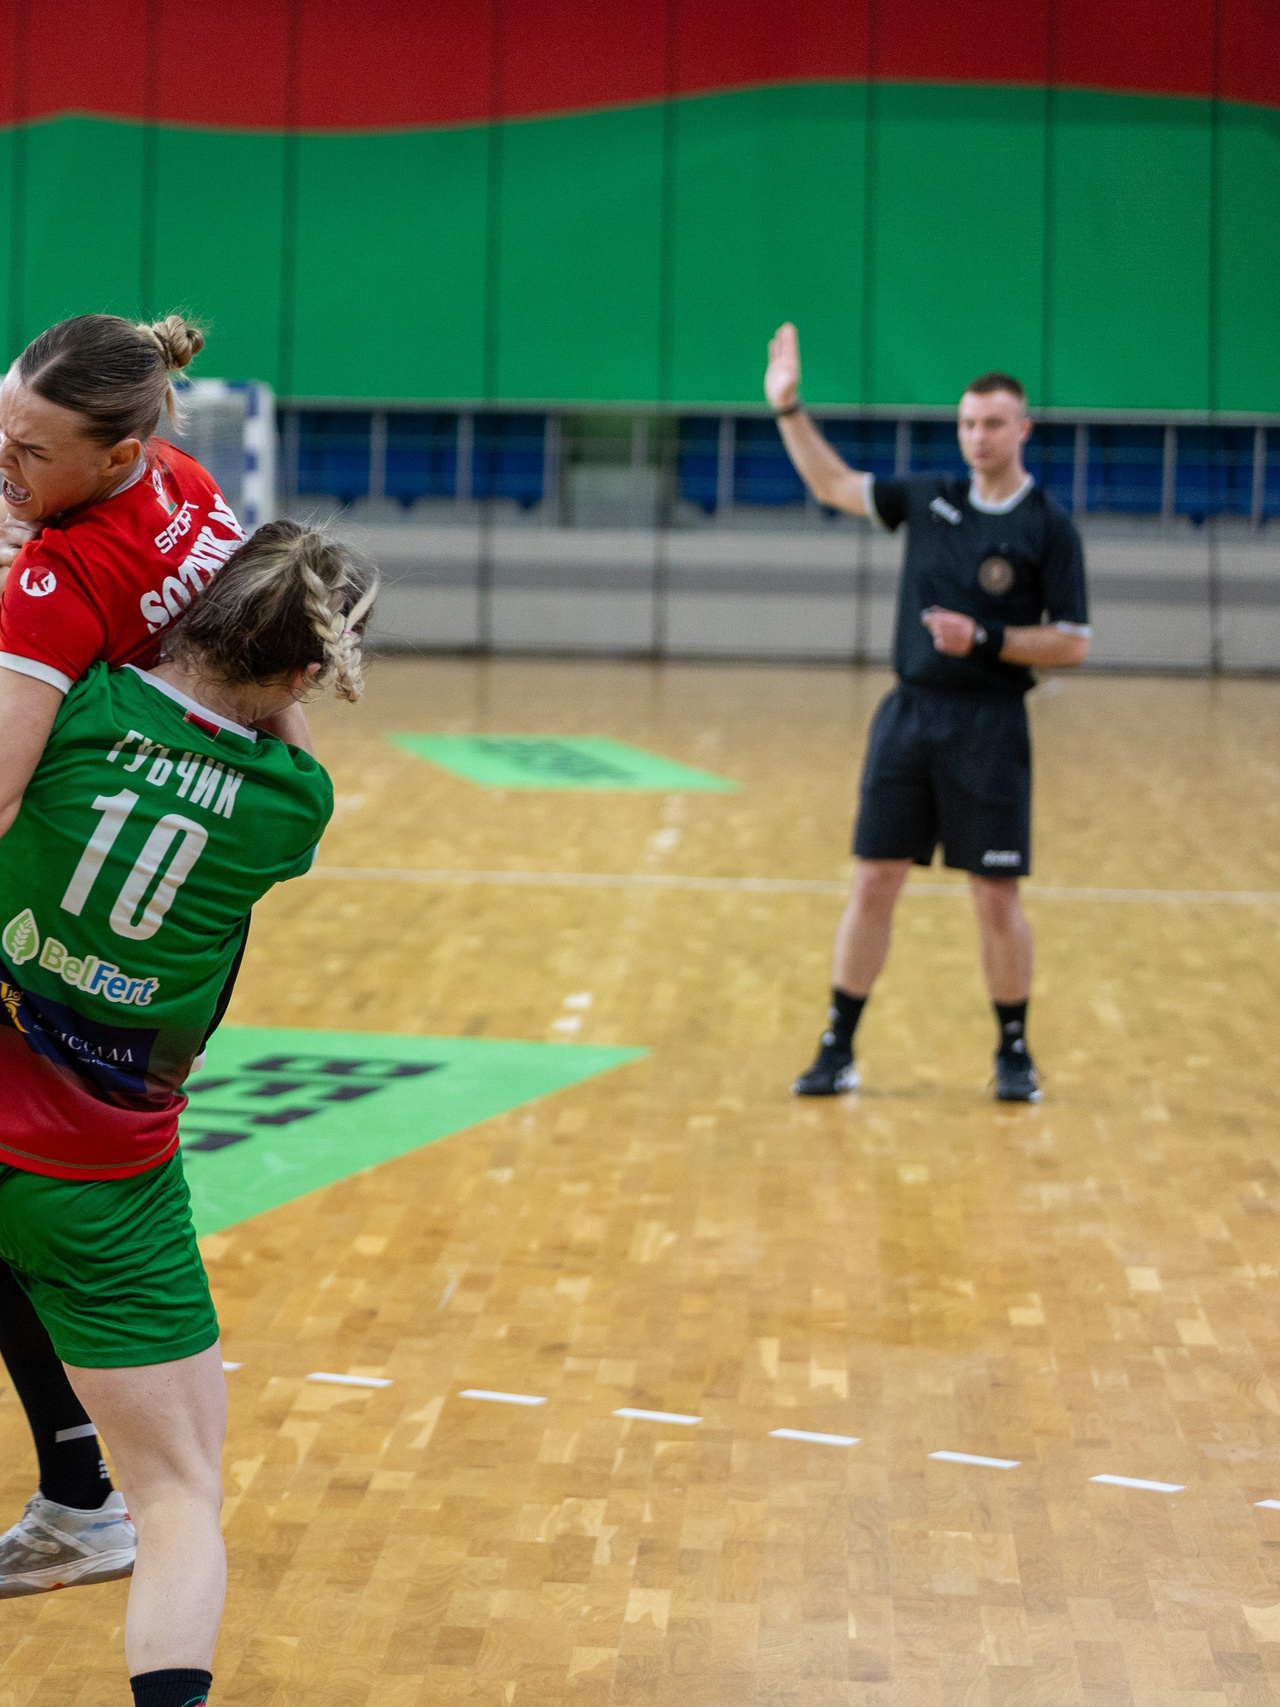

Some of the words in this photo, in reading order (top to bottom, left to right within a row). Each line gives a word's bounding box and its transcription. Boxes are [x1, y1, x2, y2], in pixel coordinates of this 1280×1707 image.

[154, 500, 199, 554] SPORT
[106, 729, 245, 819] ГУБЧИК
[60, 788, 209, 940] 10
[40, 937, 159, 1006] BelFert
